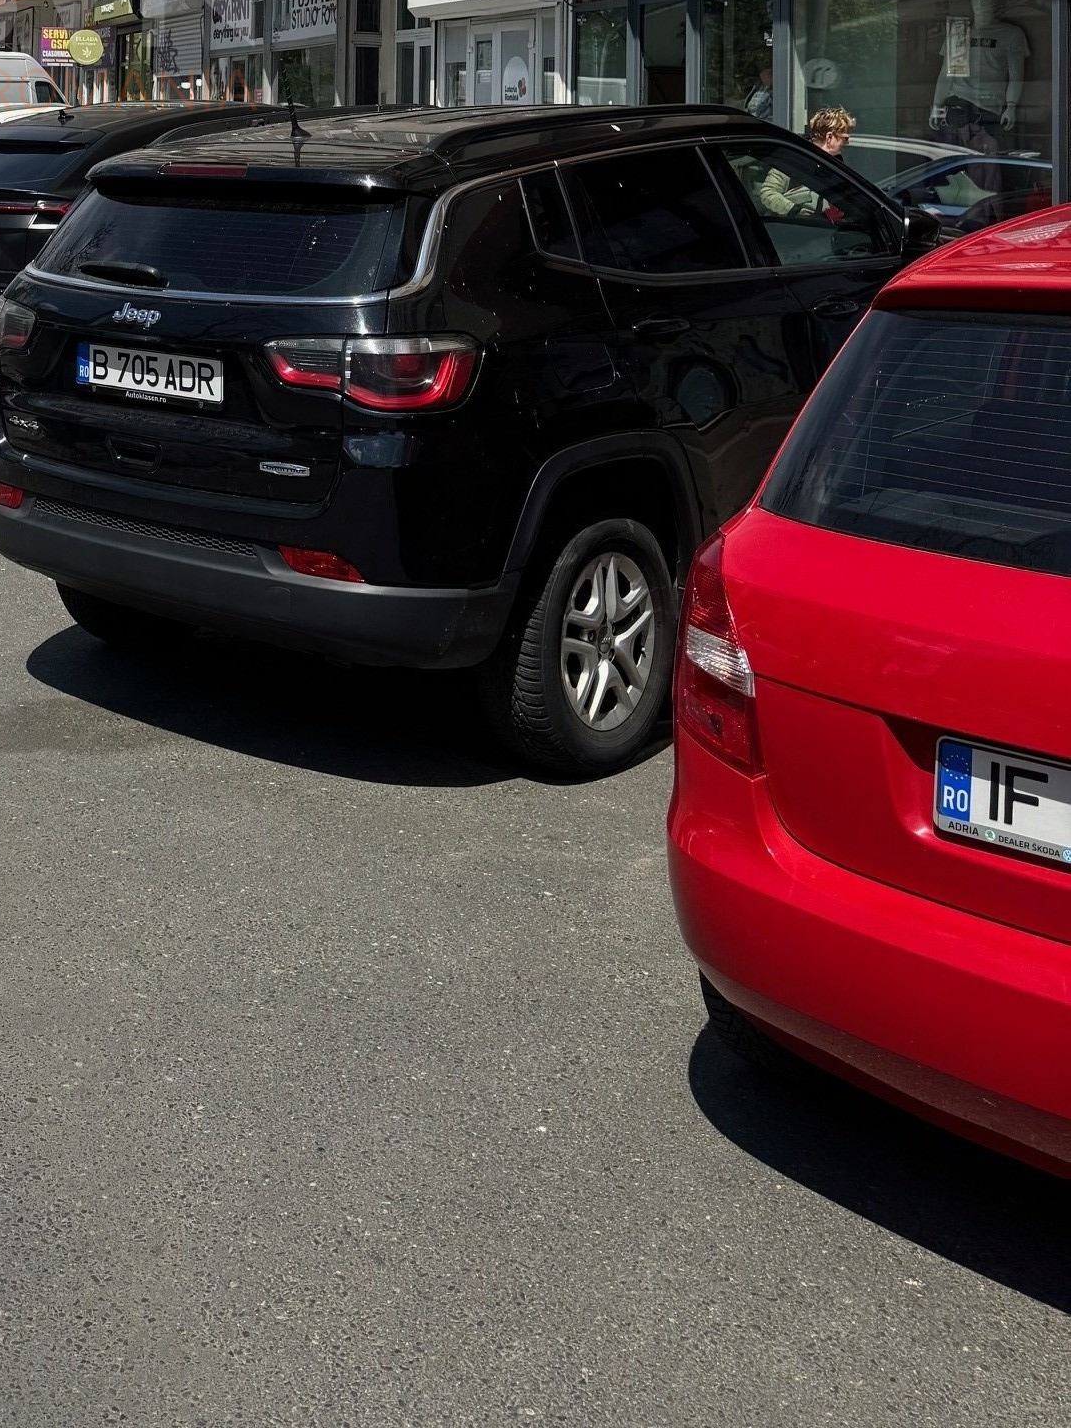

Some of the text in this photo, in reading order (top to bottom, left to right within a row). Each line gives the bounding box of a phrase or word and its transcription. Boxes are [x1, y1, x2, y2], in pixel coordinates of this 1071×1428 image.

[291, 5, 321, 30] STUDIO
[50, 39, 71, 50] GSM
[112, 302, 162, 330] Jeep
[79, 349, 215, 396] RO B 705 ADR
[942, 761, 1049, 825] RO IF
[948, 820, 1061, 858] ADRIA DEALER ŠKODA
